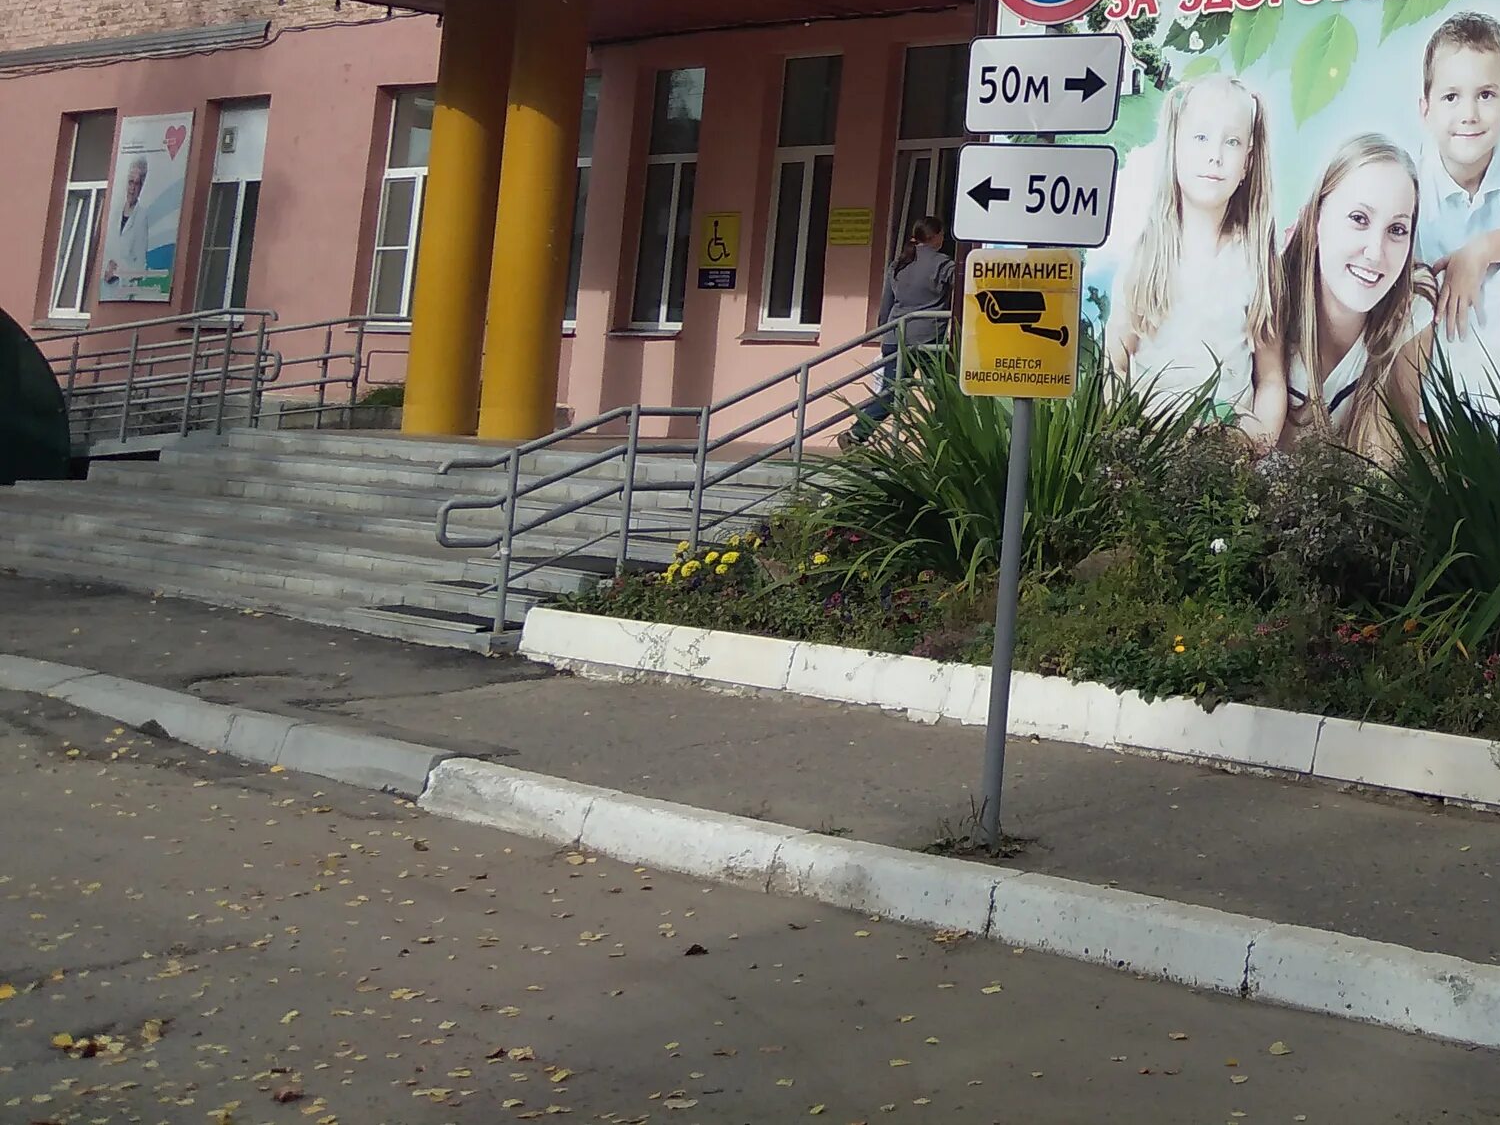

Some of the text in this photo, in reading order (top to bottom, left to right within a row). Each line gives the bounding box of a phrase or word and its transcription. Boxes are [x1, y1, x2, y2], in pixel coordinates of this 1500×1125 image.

[973, 261, 1075, 281] ВНИМАНИЕ!
[994, 354, 1042, 371] ВЕДЁТСЯ
[964, 369, 1071, 387] ВИДЕОНАБЛЮДЕНИЕ
